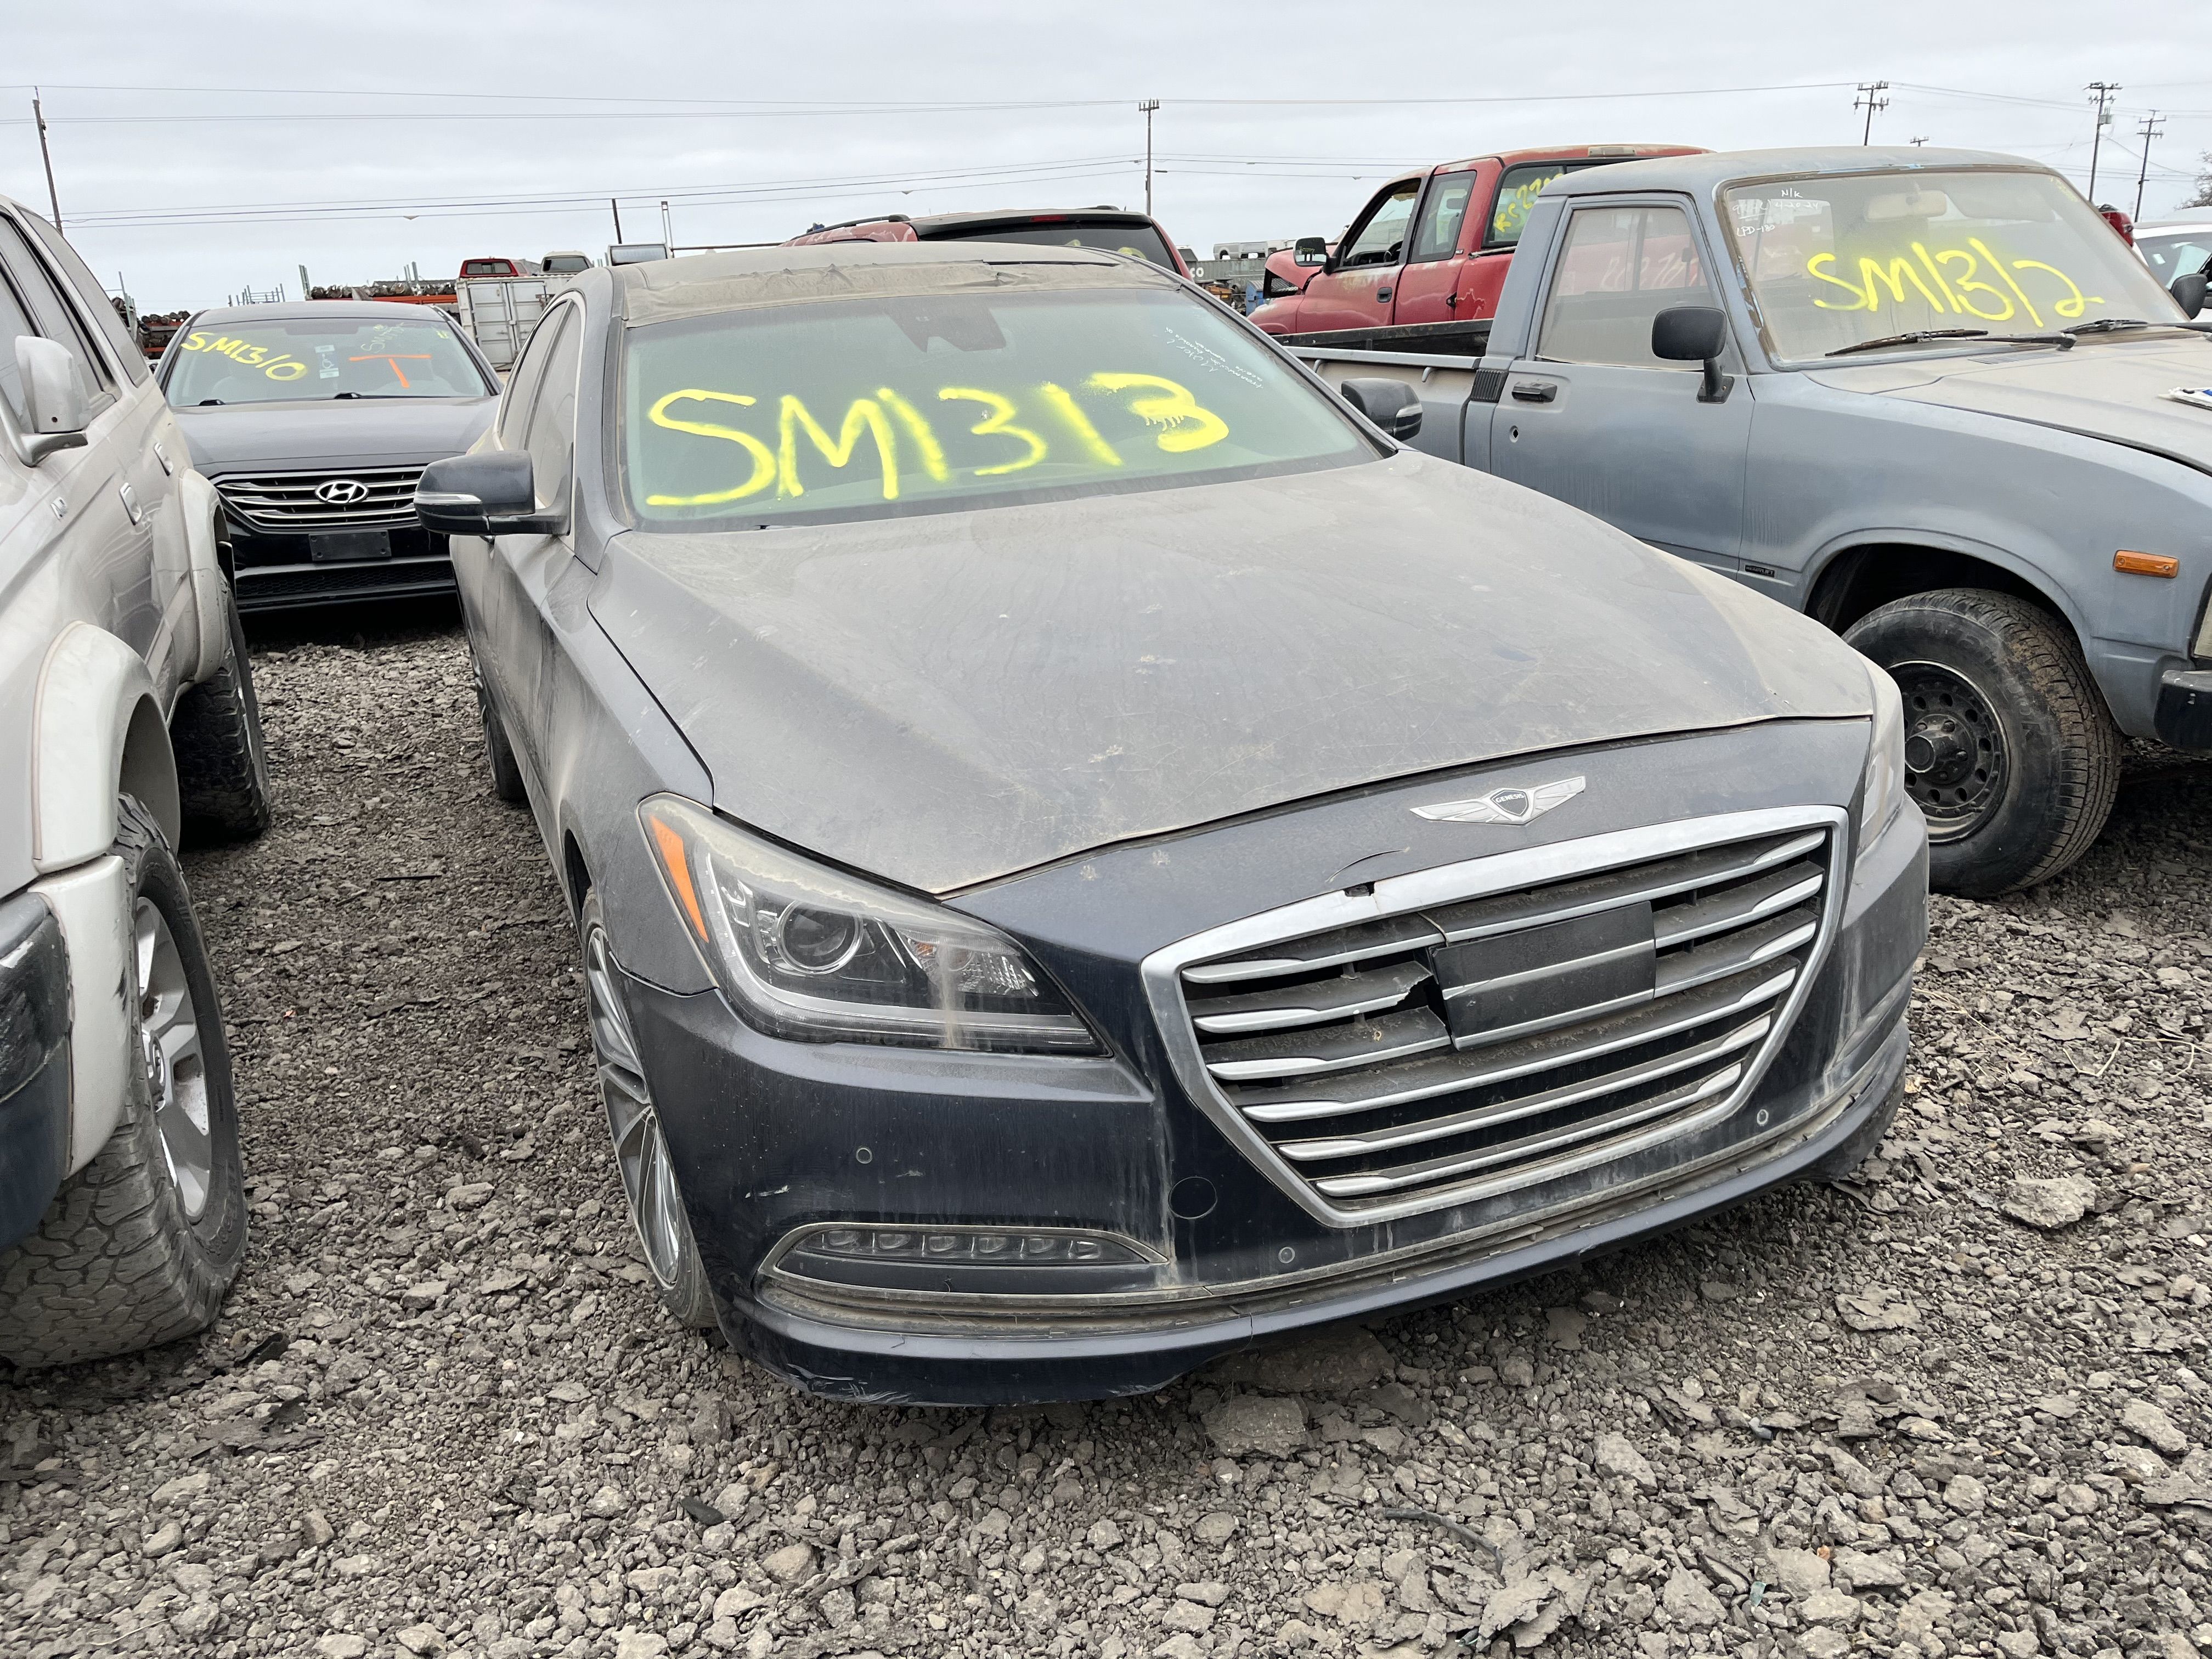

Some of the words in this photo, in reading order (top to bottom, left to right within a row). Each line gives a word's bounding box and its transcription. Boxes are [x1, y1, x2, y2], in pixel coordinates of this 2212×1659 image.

[1807, 238, 2105, 328] SM1312
[180, 332, 308, 381] SM1310
[646, 372, 1229, 505] SM1313
[1495, 793, 1525, 803] GENESIS
